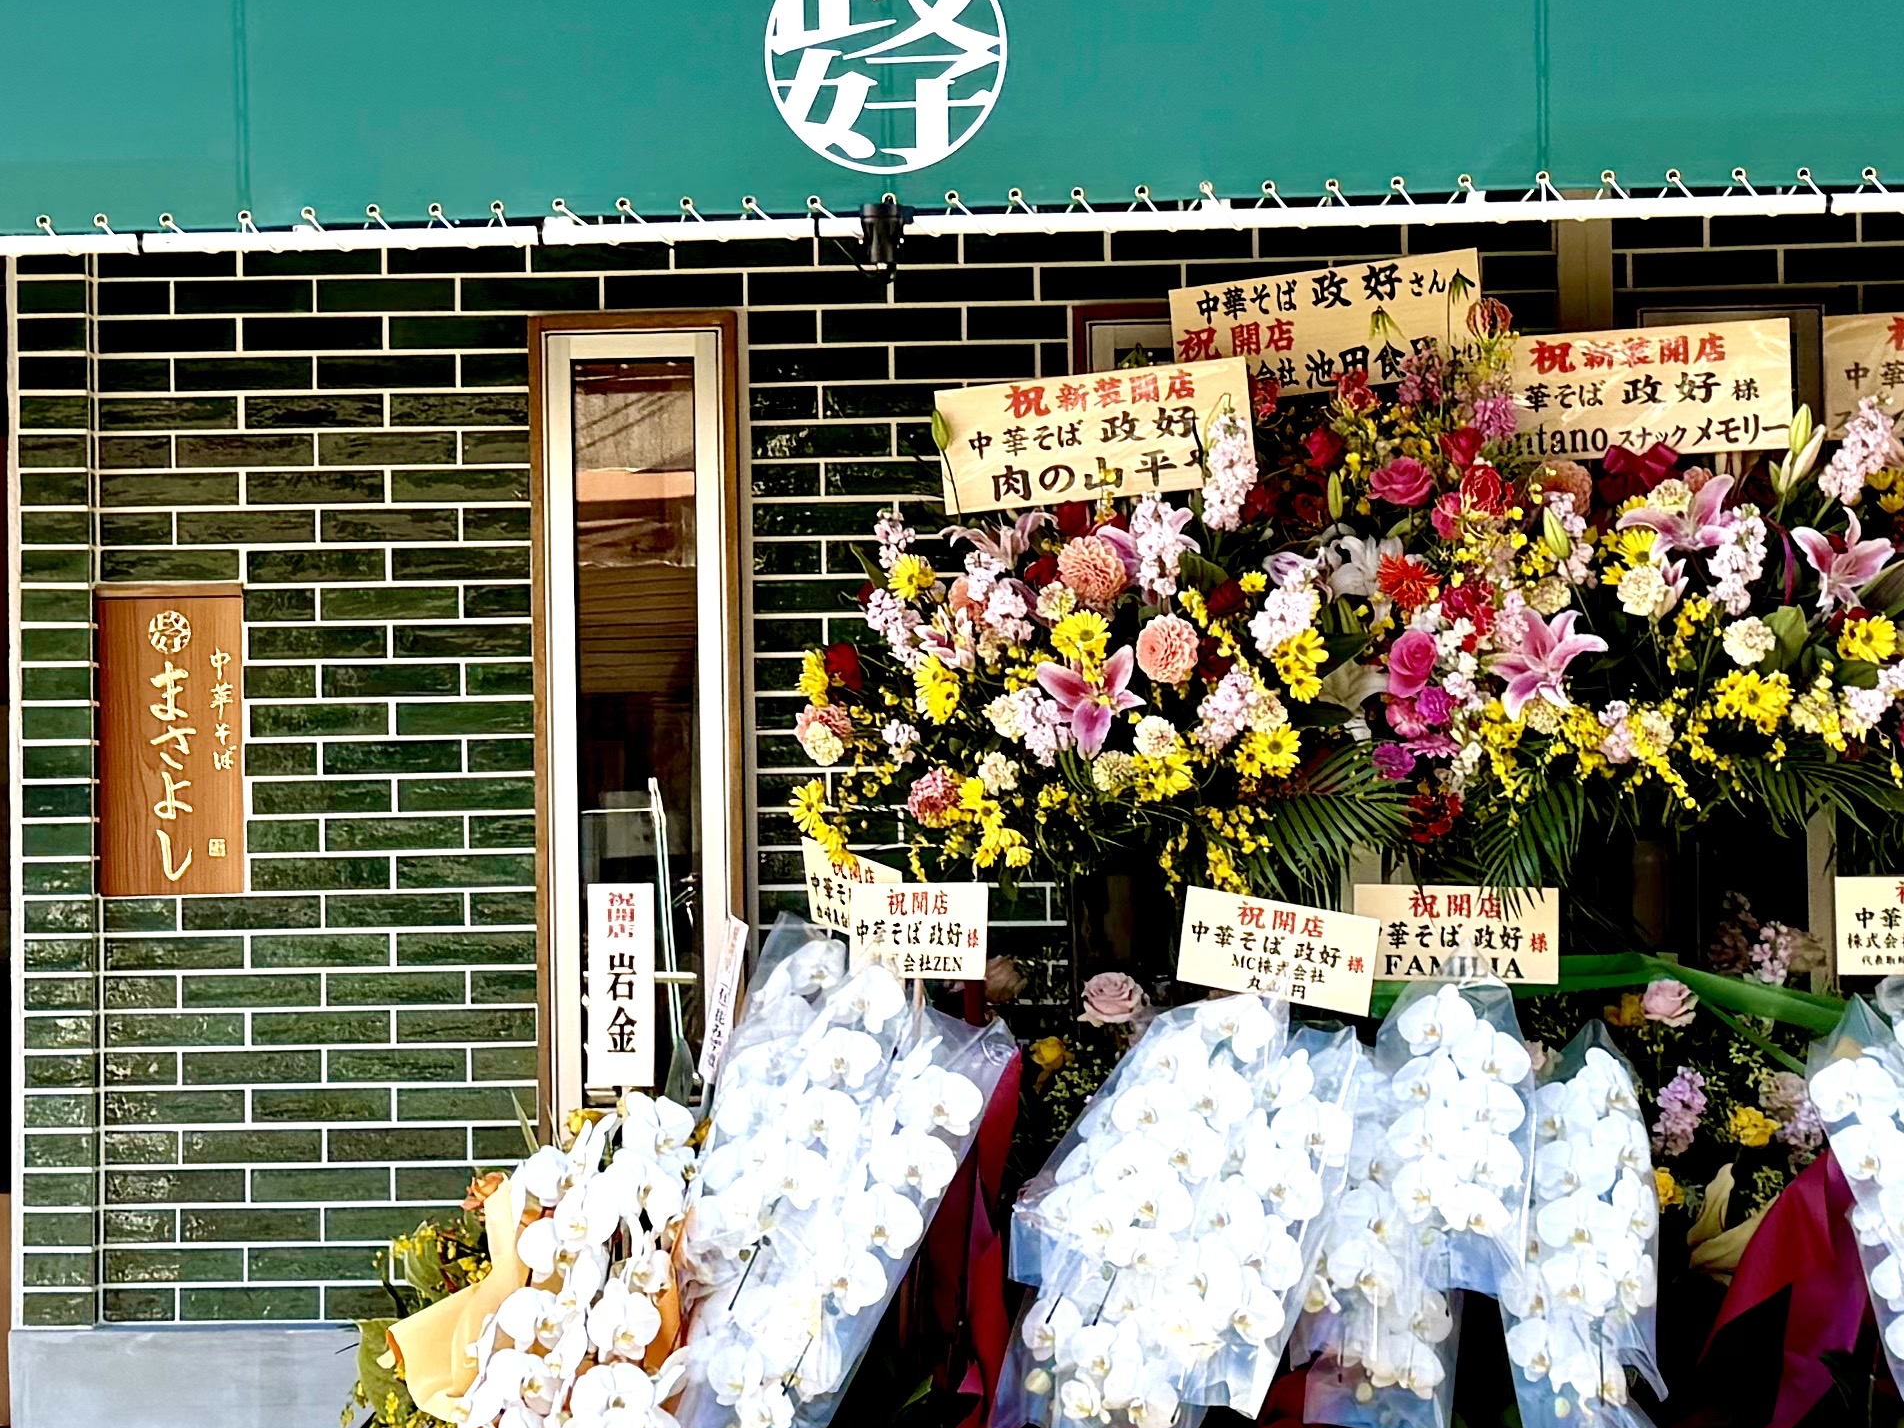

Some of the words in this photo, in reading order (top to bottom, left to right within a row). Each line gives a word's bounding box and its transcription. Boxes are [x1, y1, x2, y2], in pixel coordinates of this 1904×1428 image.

[1197, 280, 1297, 325] 中華そば
[1312, 263, 1402, 309] 政好
[1177, 317, 1294, 363] 祝開店
[1004, 368, 1196, 419] 祝新装開店
[1622, 372, 1721, 404] 政好
[1731, 378, 1759, 401] 様
[968, 419, 1083, 460] 中華そば
[1100, 406, 1200, 443] 政好
[209, 648, 236, 771] 中華そば
[150, 661, 196, 882] まさよし
[886, 889, 948, 916] 祝開店
[1237, 900, 1325, 939] 祝開店
[1409, 890, 1502, 920] 祝開店
[856, 920, 922, 946] 中華そば
[1191, 920, 1286, 955] 中華そば
[1347, 956, 1364, 973] 様
[1529, 933, 1548, 954] 様
[1385, 954, 1524, 979] FAMILIA
[606, 952, 638, 1053] 岩金
